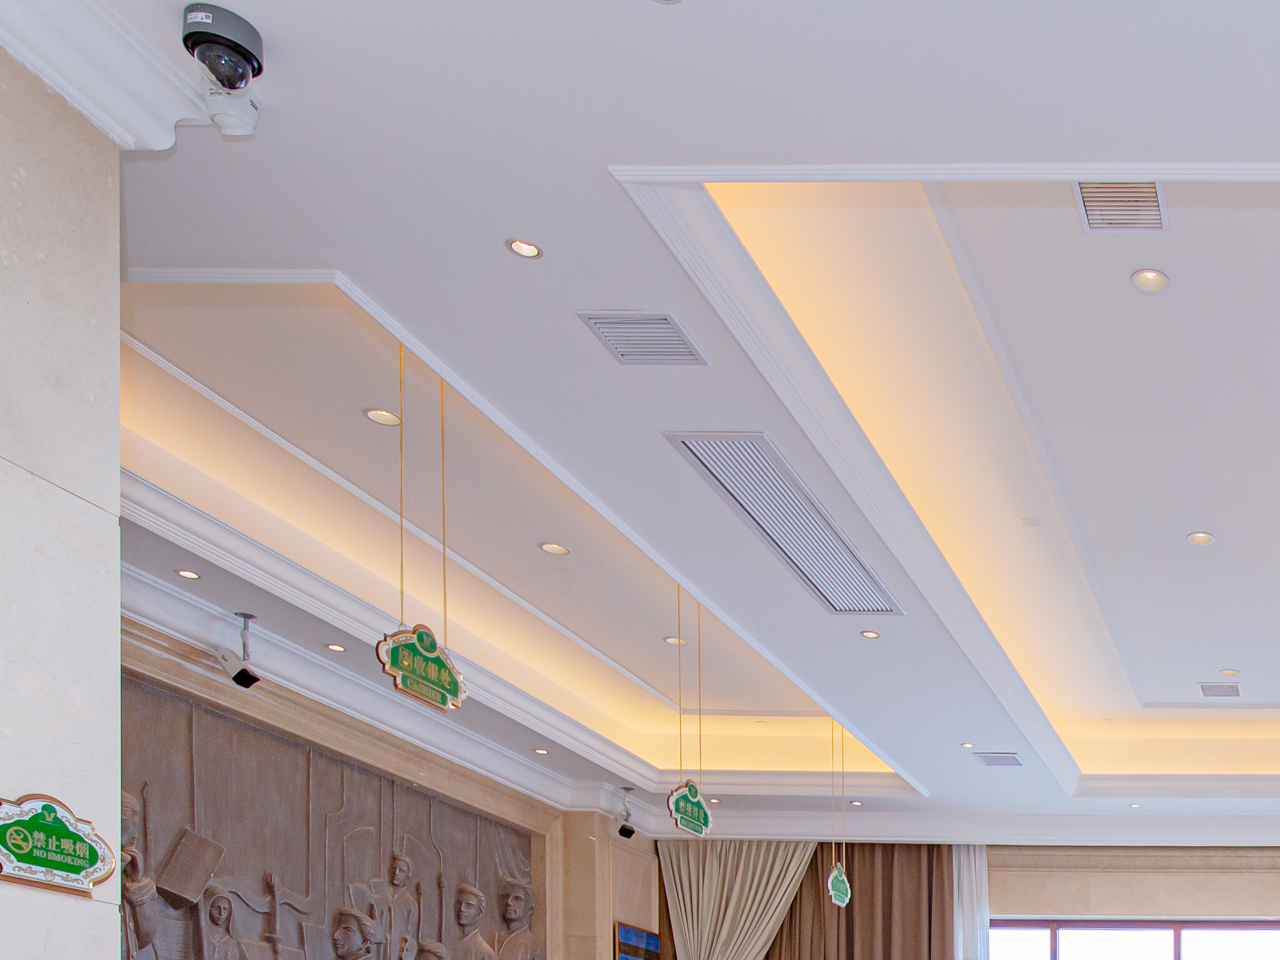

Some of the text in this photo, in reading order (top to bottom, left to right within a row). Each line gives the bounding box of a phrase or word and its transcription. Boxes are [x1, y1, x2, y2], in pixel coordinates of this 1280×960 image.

[414, 655, 451, 689] 收银处
[407, 679, 442, 702] CASHIER
[32, 831, 89, 859] 禁止吸烟
[33, 849, 89, 867] NO SMOKING
